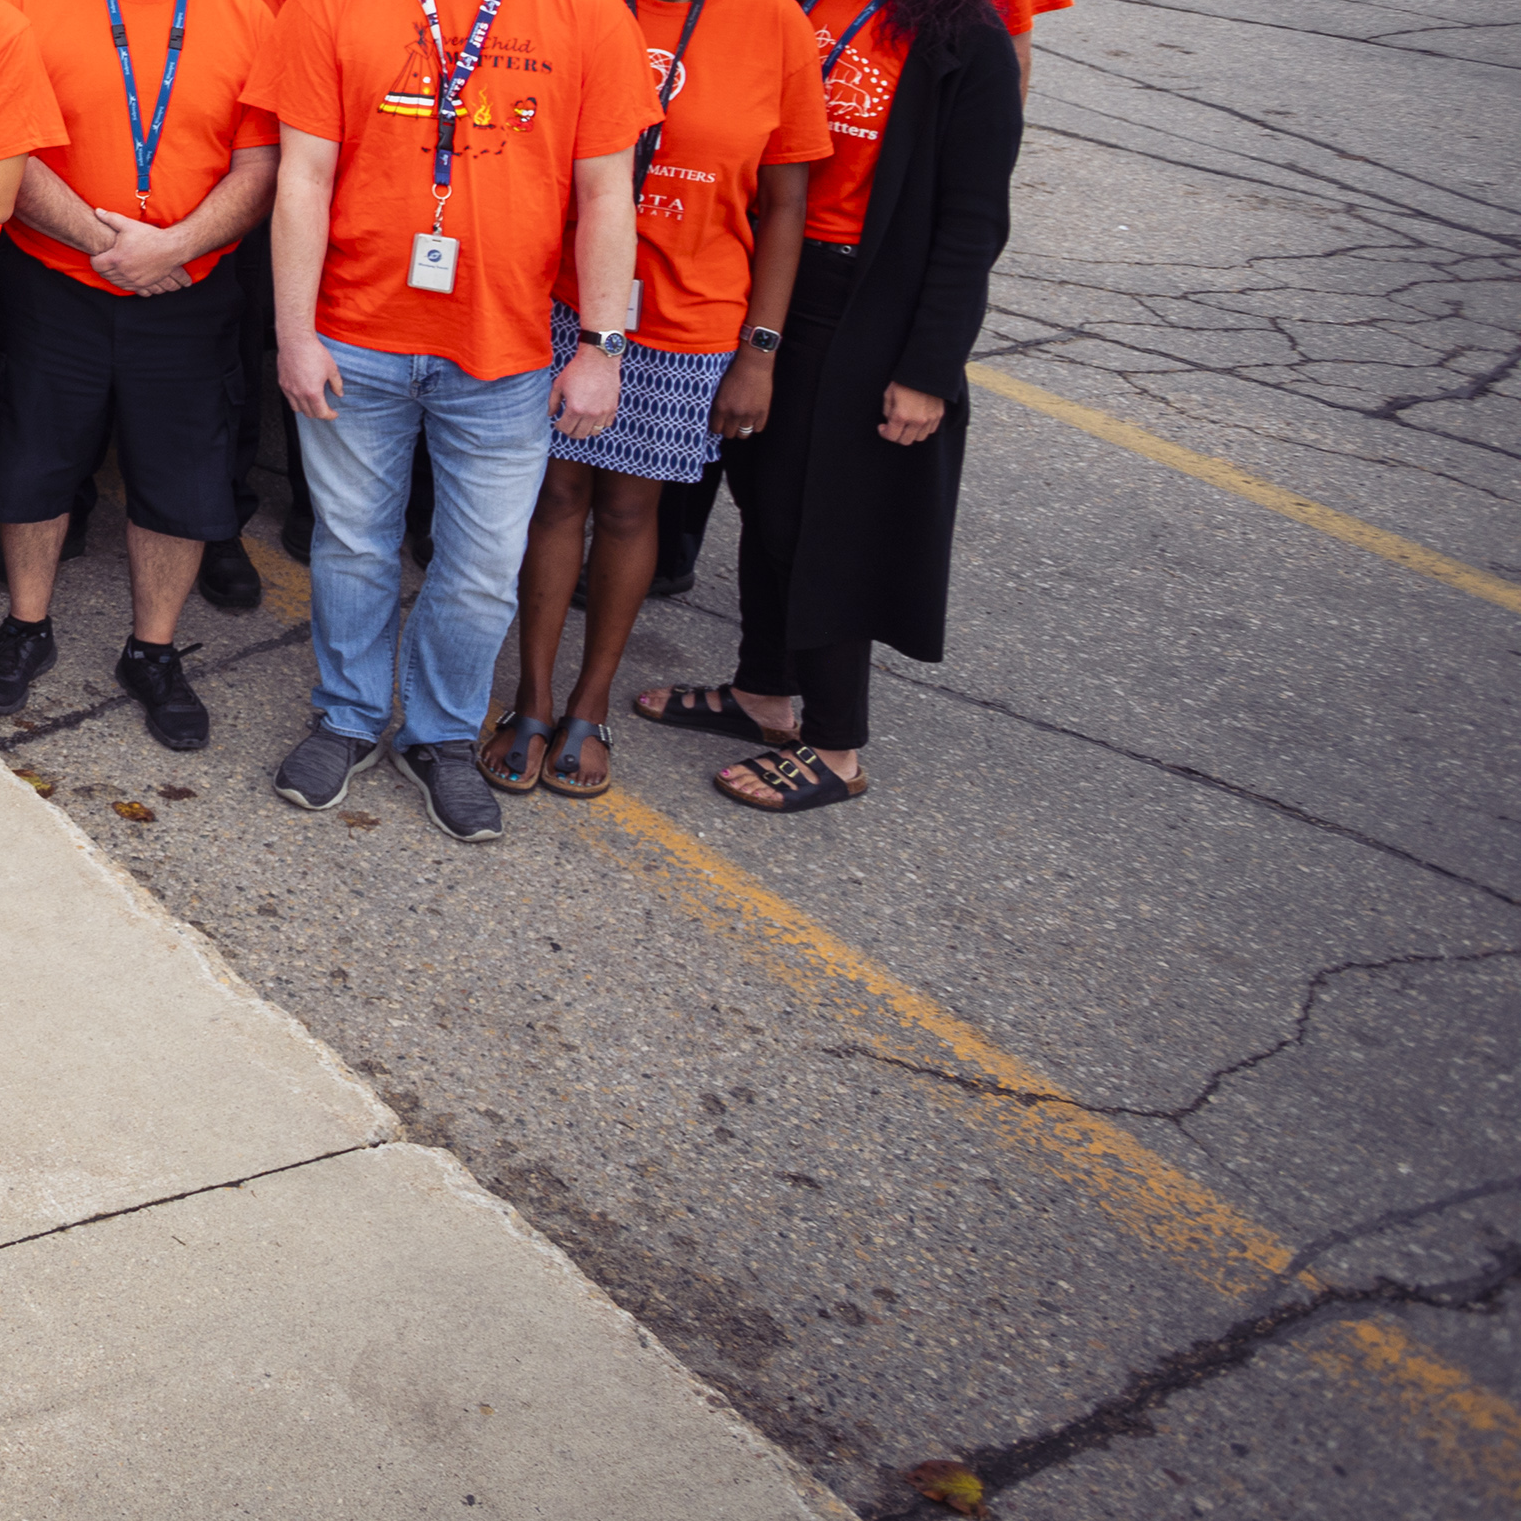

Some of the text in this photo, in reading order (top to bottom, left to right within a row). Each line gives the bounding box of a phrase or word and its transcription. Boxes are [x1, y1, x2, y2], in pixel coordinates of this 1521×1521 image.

[472, 22, 489, 48] JETS
[446, 51, 553, 74] MTTERS
[648, 165, 716, 183] MATTERS
